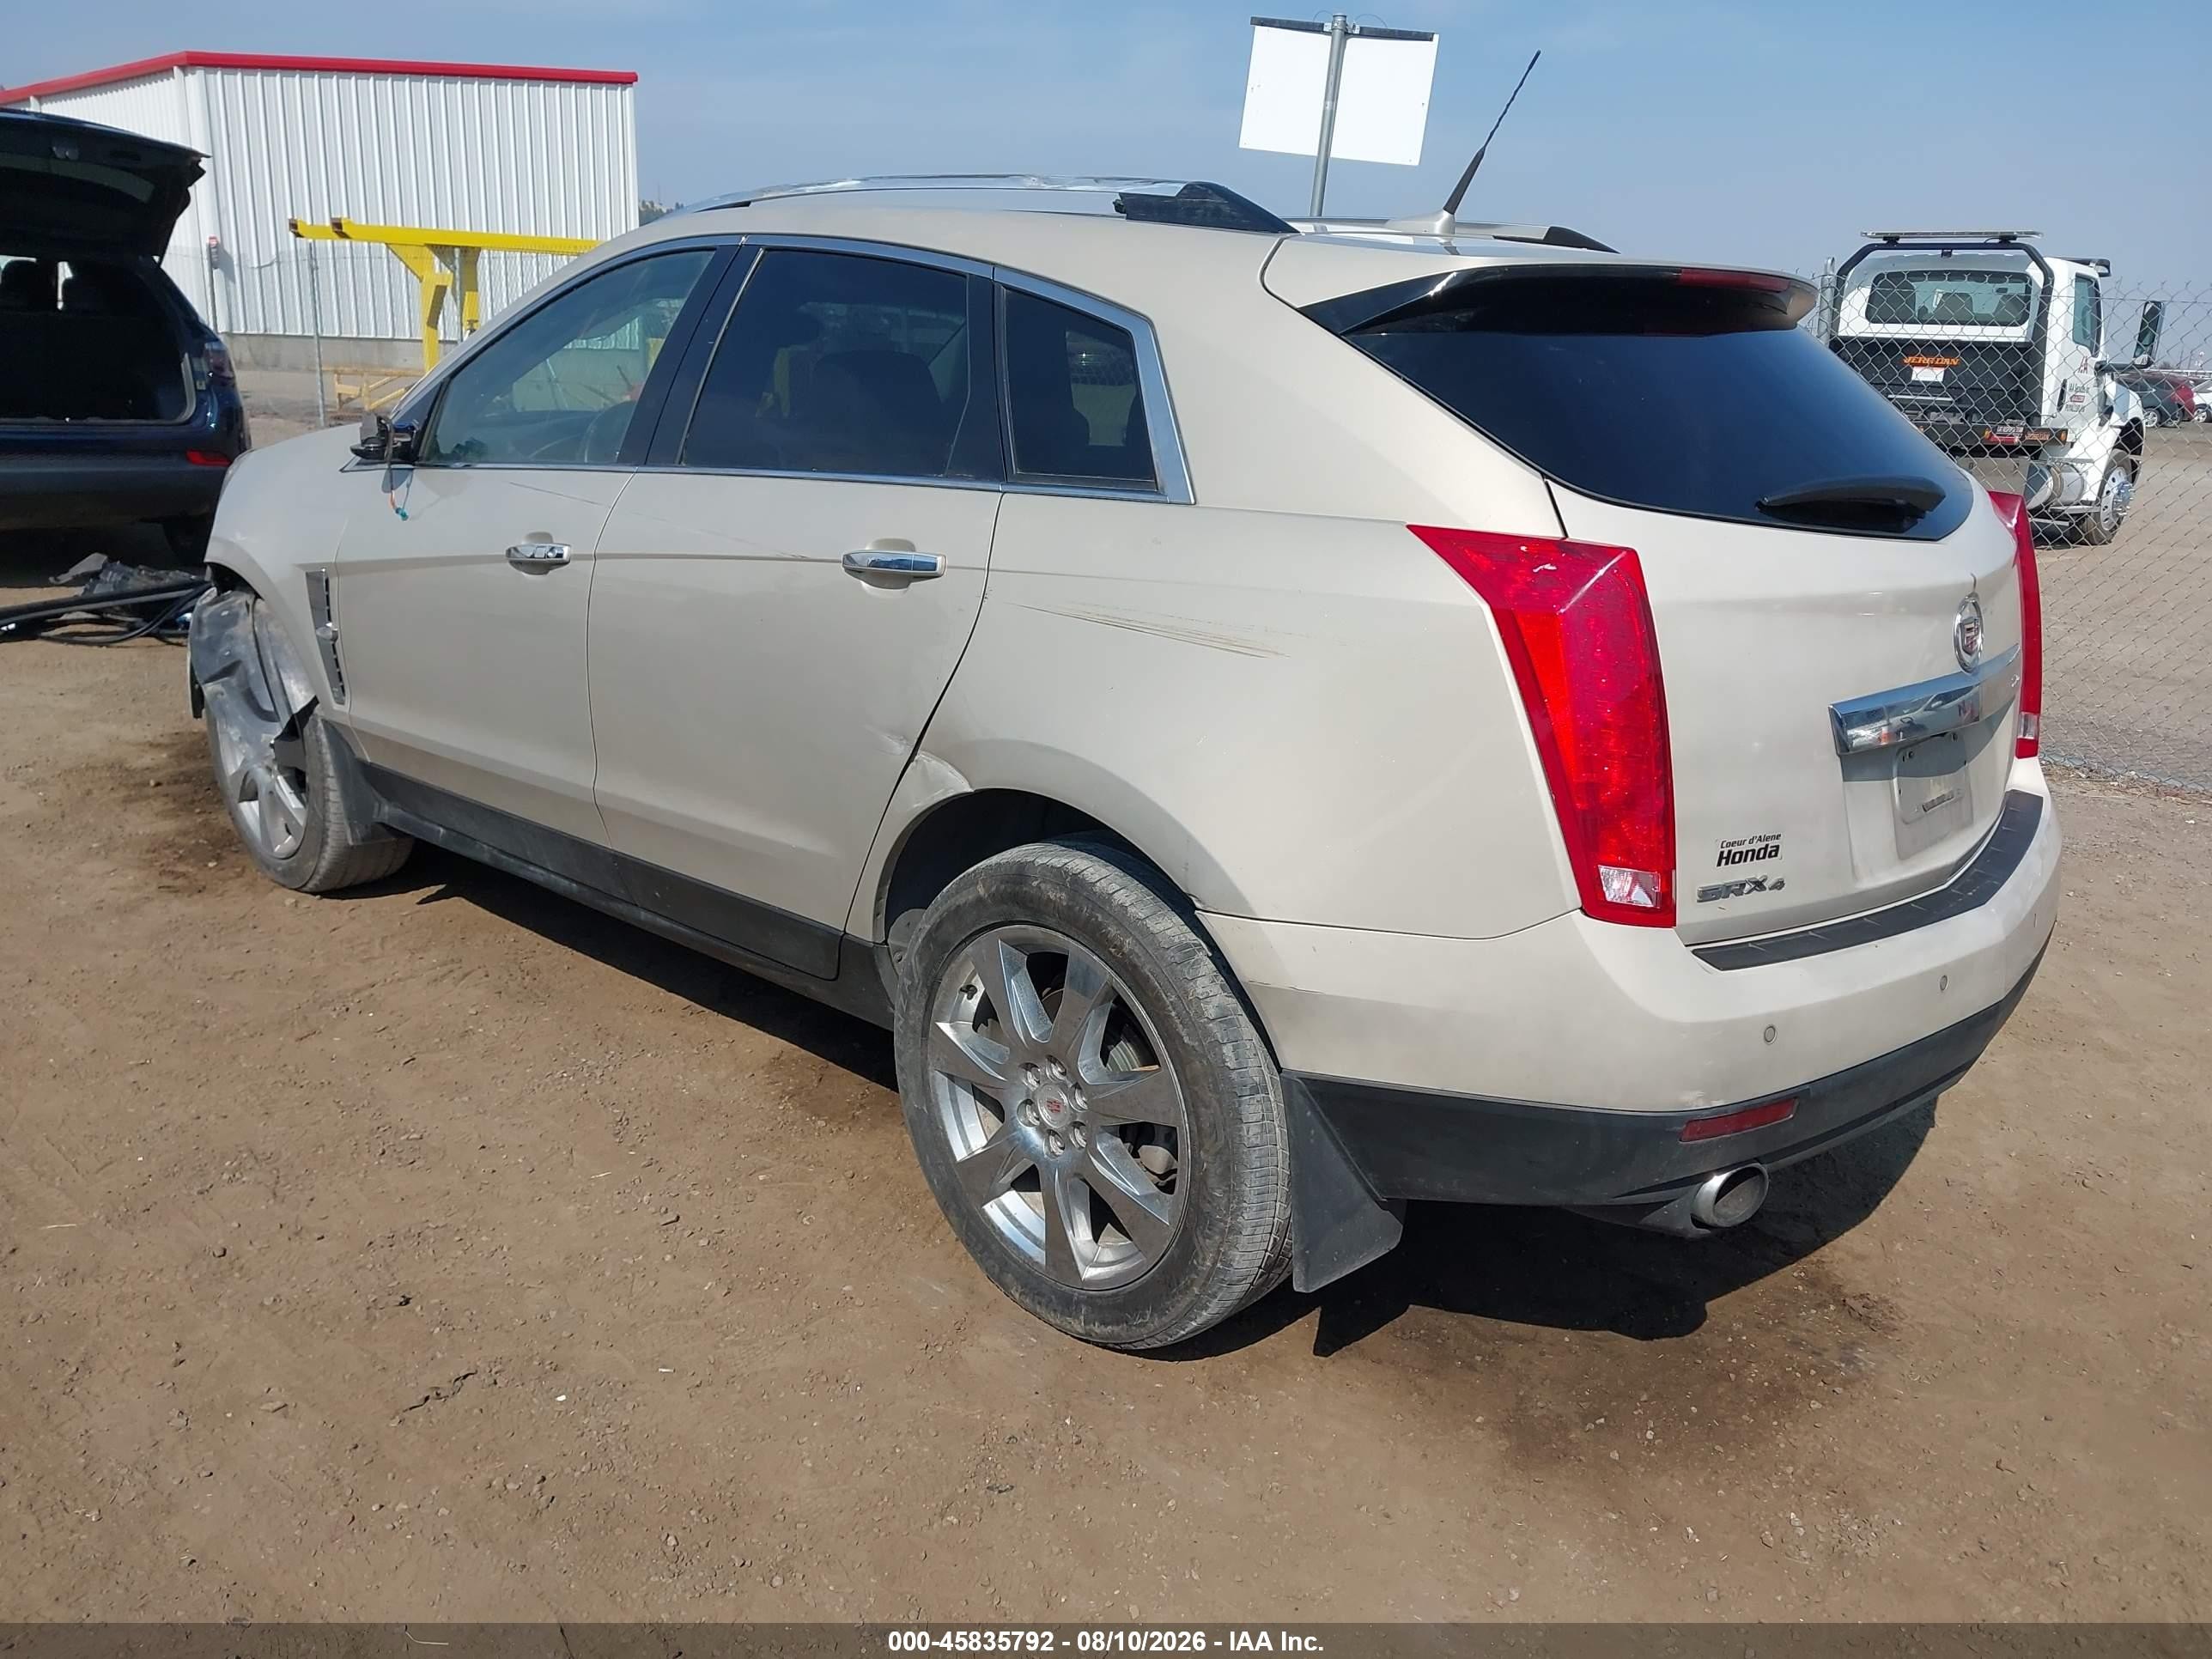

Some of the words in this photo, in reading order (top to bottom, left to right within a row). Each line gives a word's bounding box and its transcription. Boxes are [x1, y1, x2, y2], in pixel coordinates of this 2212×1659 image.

[1720, 838, 1747, 849] Coeur
[1748, 833, 1782, 845] d'Alene
[1716, 844, 1780, 867] Honda
[1697, 875, 1768, 903] SRX
